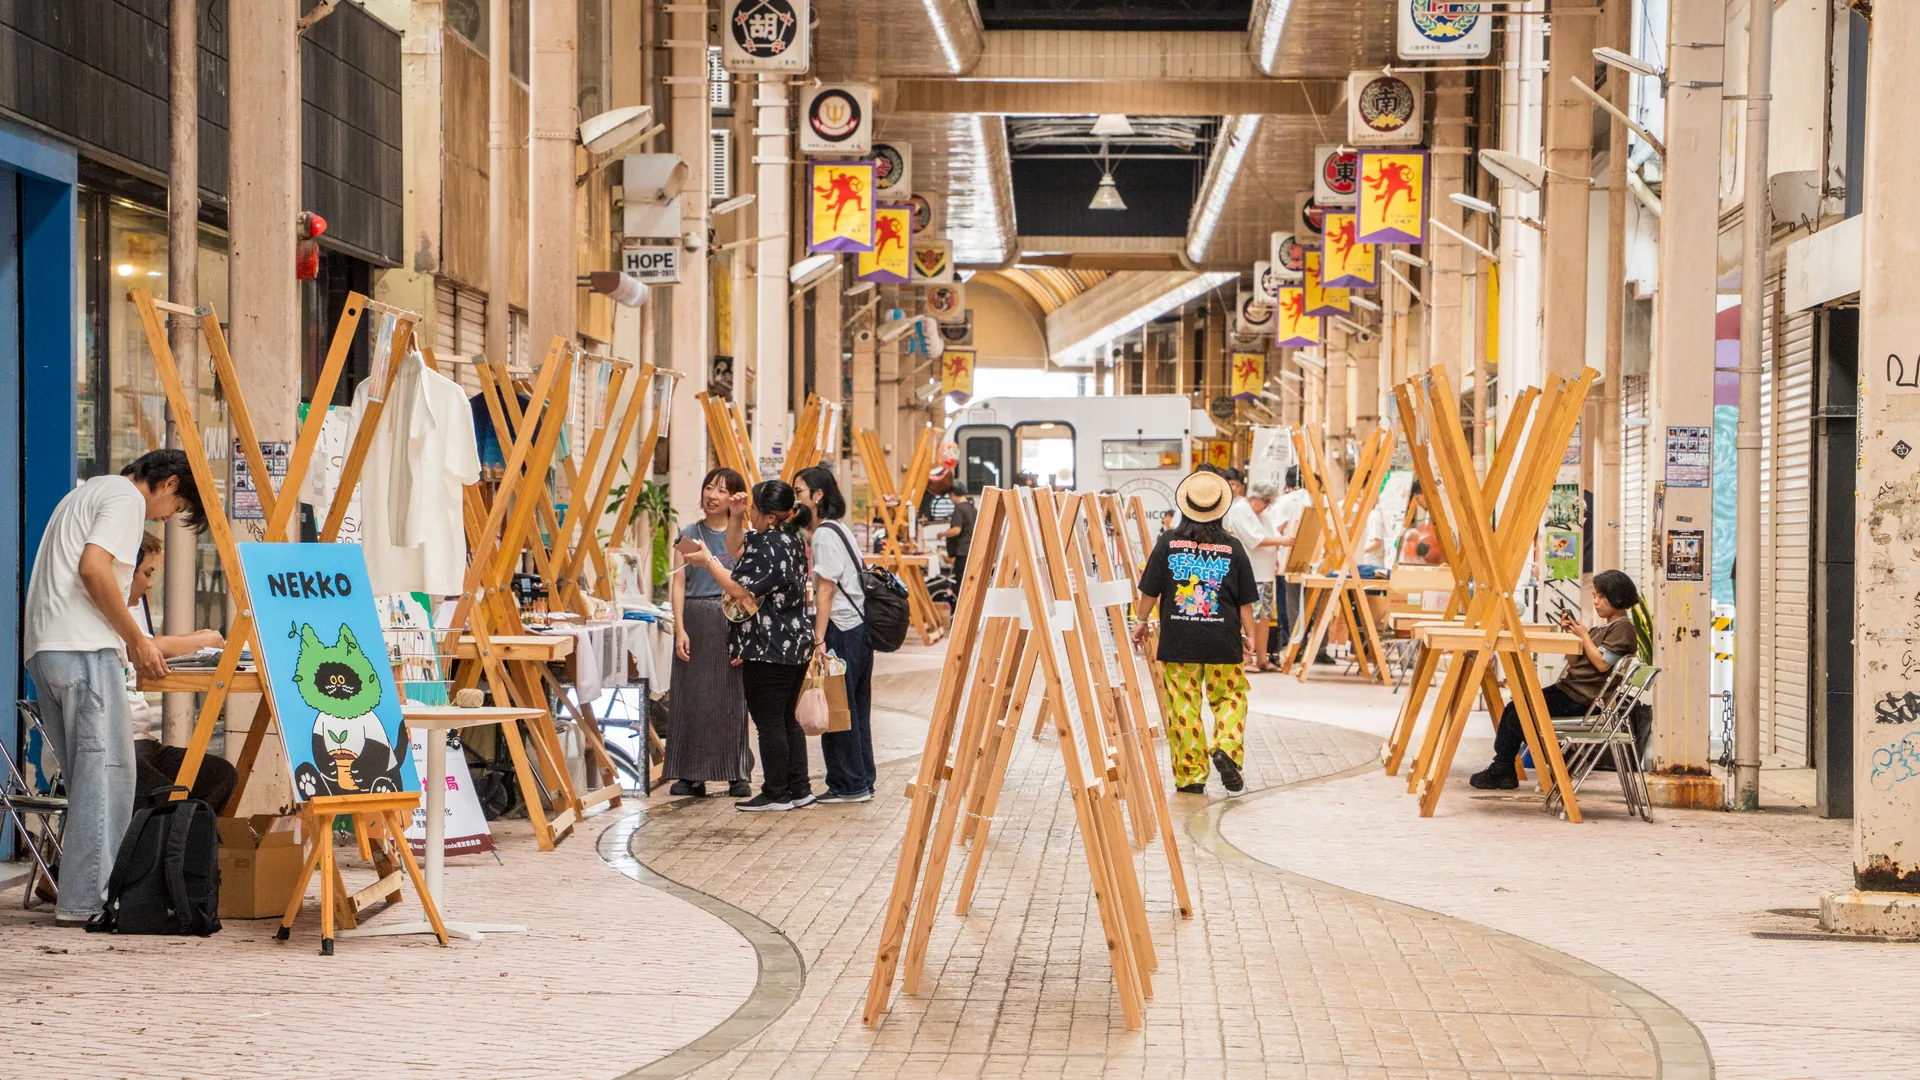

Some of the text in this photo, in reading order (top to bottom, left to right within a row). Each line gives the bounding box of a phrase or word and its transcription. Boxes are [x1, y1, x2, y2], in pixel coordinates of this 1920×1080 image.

[748, 13, 778, 41] 胡
[1375, 88, 1399, 112] 南
[1334, 162, 1357, 183] 東
[627, 252, 674, 269] HOPE
[1170, 541, 1232, 554] RODEO CROWNS
[1168, 553, 1230, 572] SESAME
[268, 571, 352, 598] NEKKO
[1173, 566, 1226, 583] STREET
